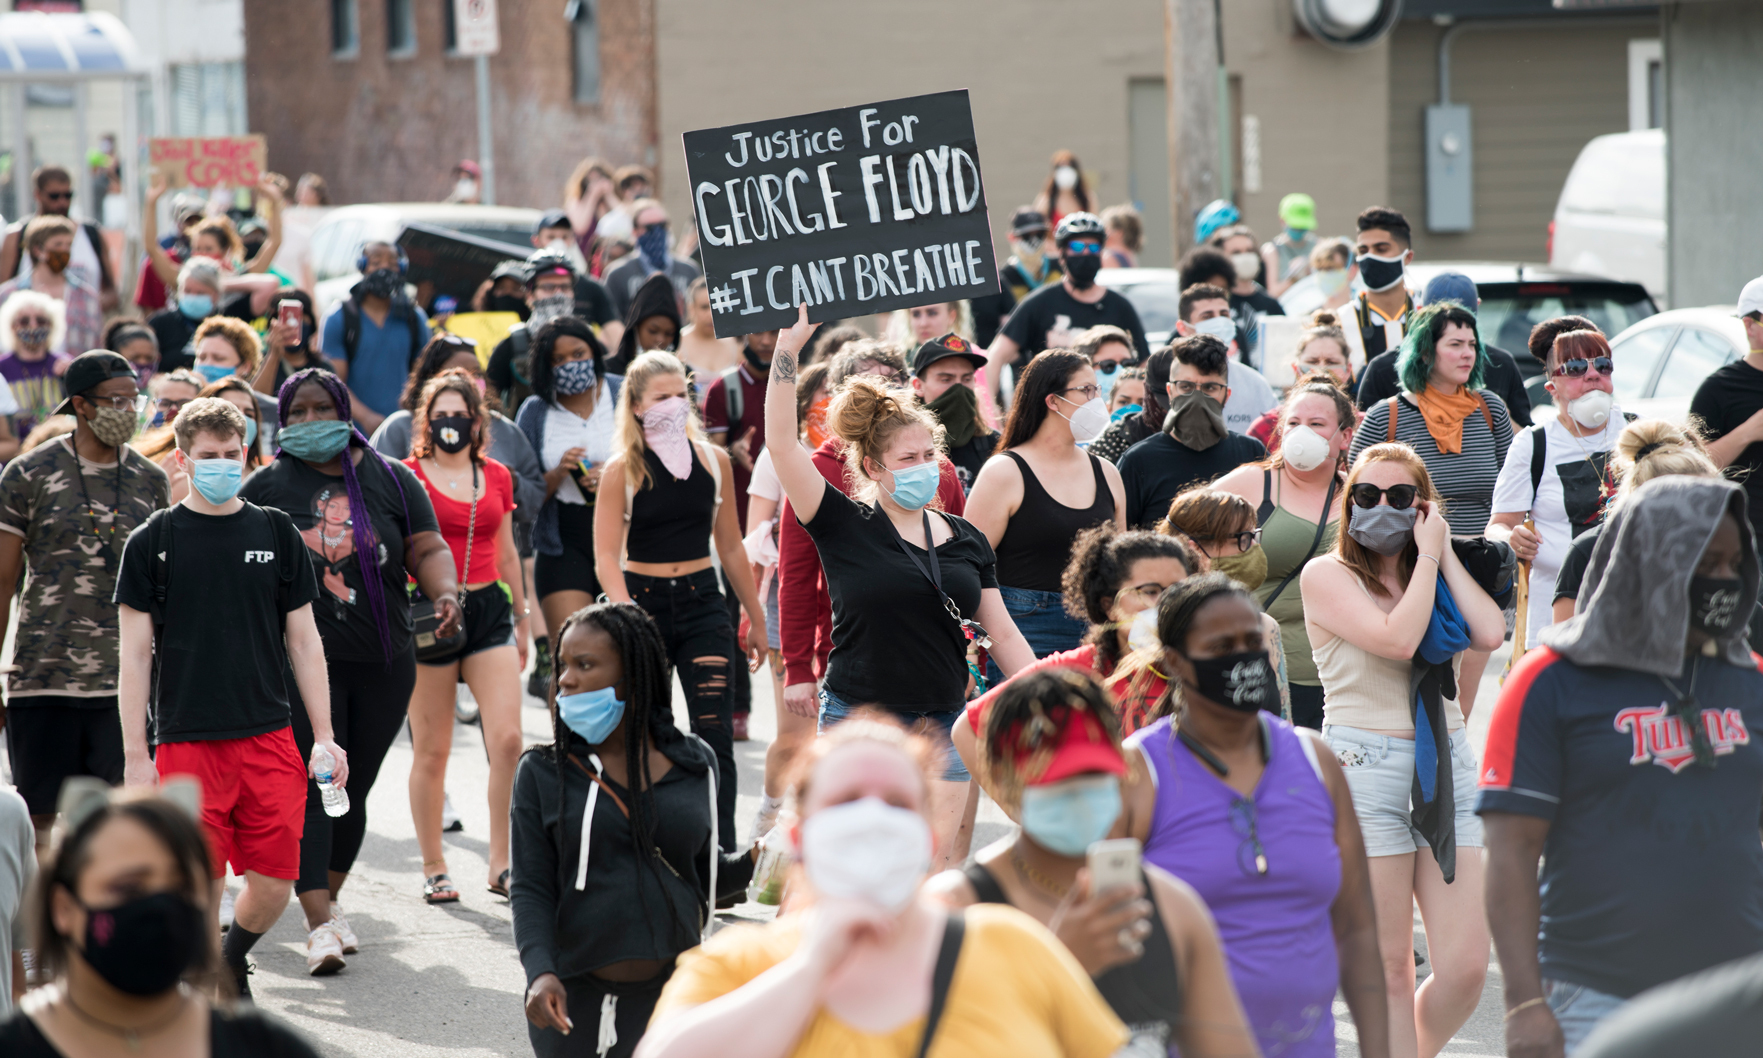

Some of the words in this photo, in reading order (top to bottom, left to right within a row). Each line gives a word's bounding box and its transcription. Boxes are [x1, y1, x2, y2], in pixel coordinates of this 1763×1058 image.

[725, 127, 845, 167] Justice
[859, 108, 919, 149] For
[695, 161, 848, 247] GEORGE
[859, 145, 980, 224] FLOYD
[853, 240, 986, 301] BREATHE
[1227, 414, 1252, 423] KORS
[244, 550, 275, 563] FTP
[1613, 701, 1750, 766] Twns
